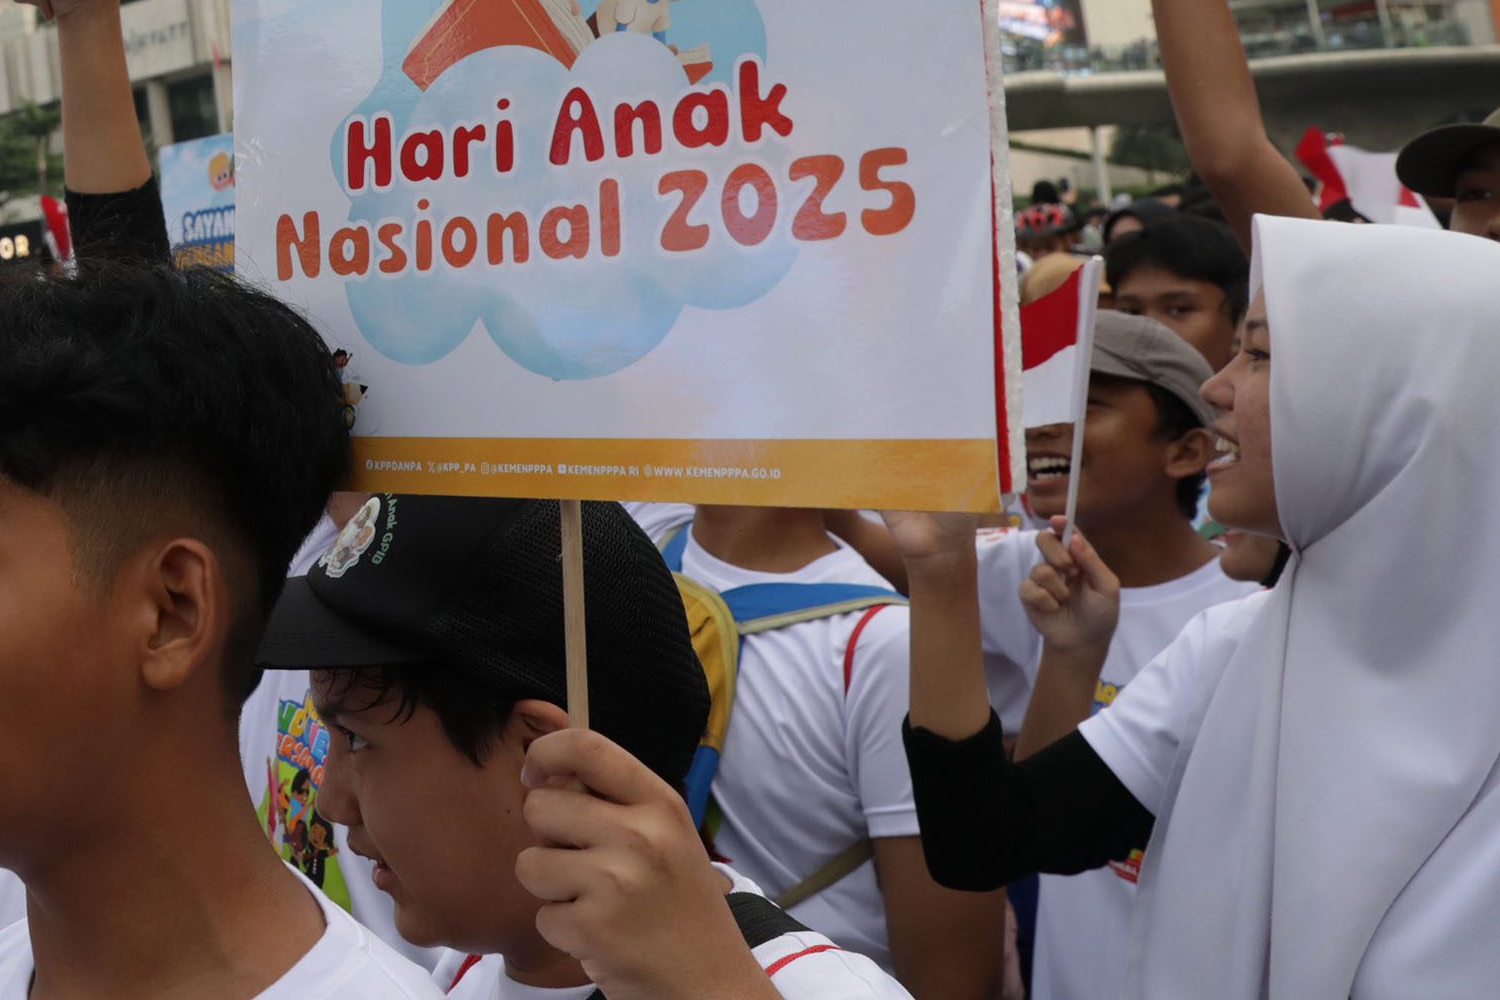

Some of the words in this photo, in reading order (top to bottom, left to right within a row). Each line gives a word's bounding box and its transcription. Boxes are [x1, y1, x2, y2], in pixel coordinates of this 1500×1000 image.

[347, 98, 514, 190] Hari
[549, 60, 793, 166] Anak
[276, 178, 621, 281] Nasional
[658, 147, 915, 252] 2025
[374, 460, 423, 472] KPPDANPA
[437, 462, 476, 474] @KPP_PA
[491, 463, 553, 474] @KEMENPPPA
[567, 464, 626, 476] KEMENPPPA
[628, 466, 639, 477] RI
[654, 466, 782, 479] WWW.KEMENPPPA.GO.ID
[387, 498, 398, 530] Anak
